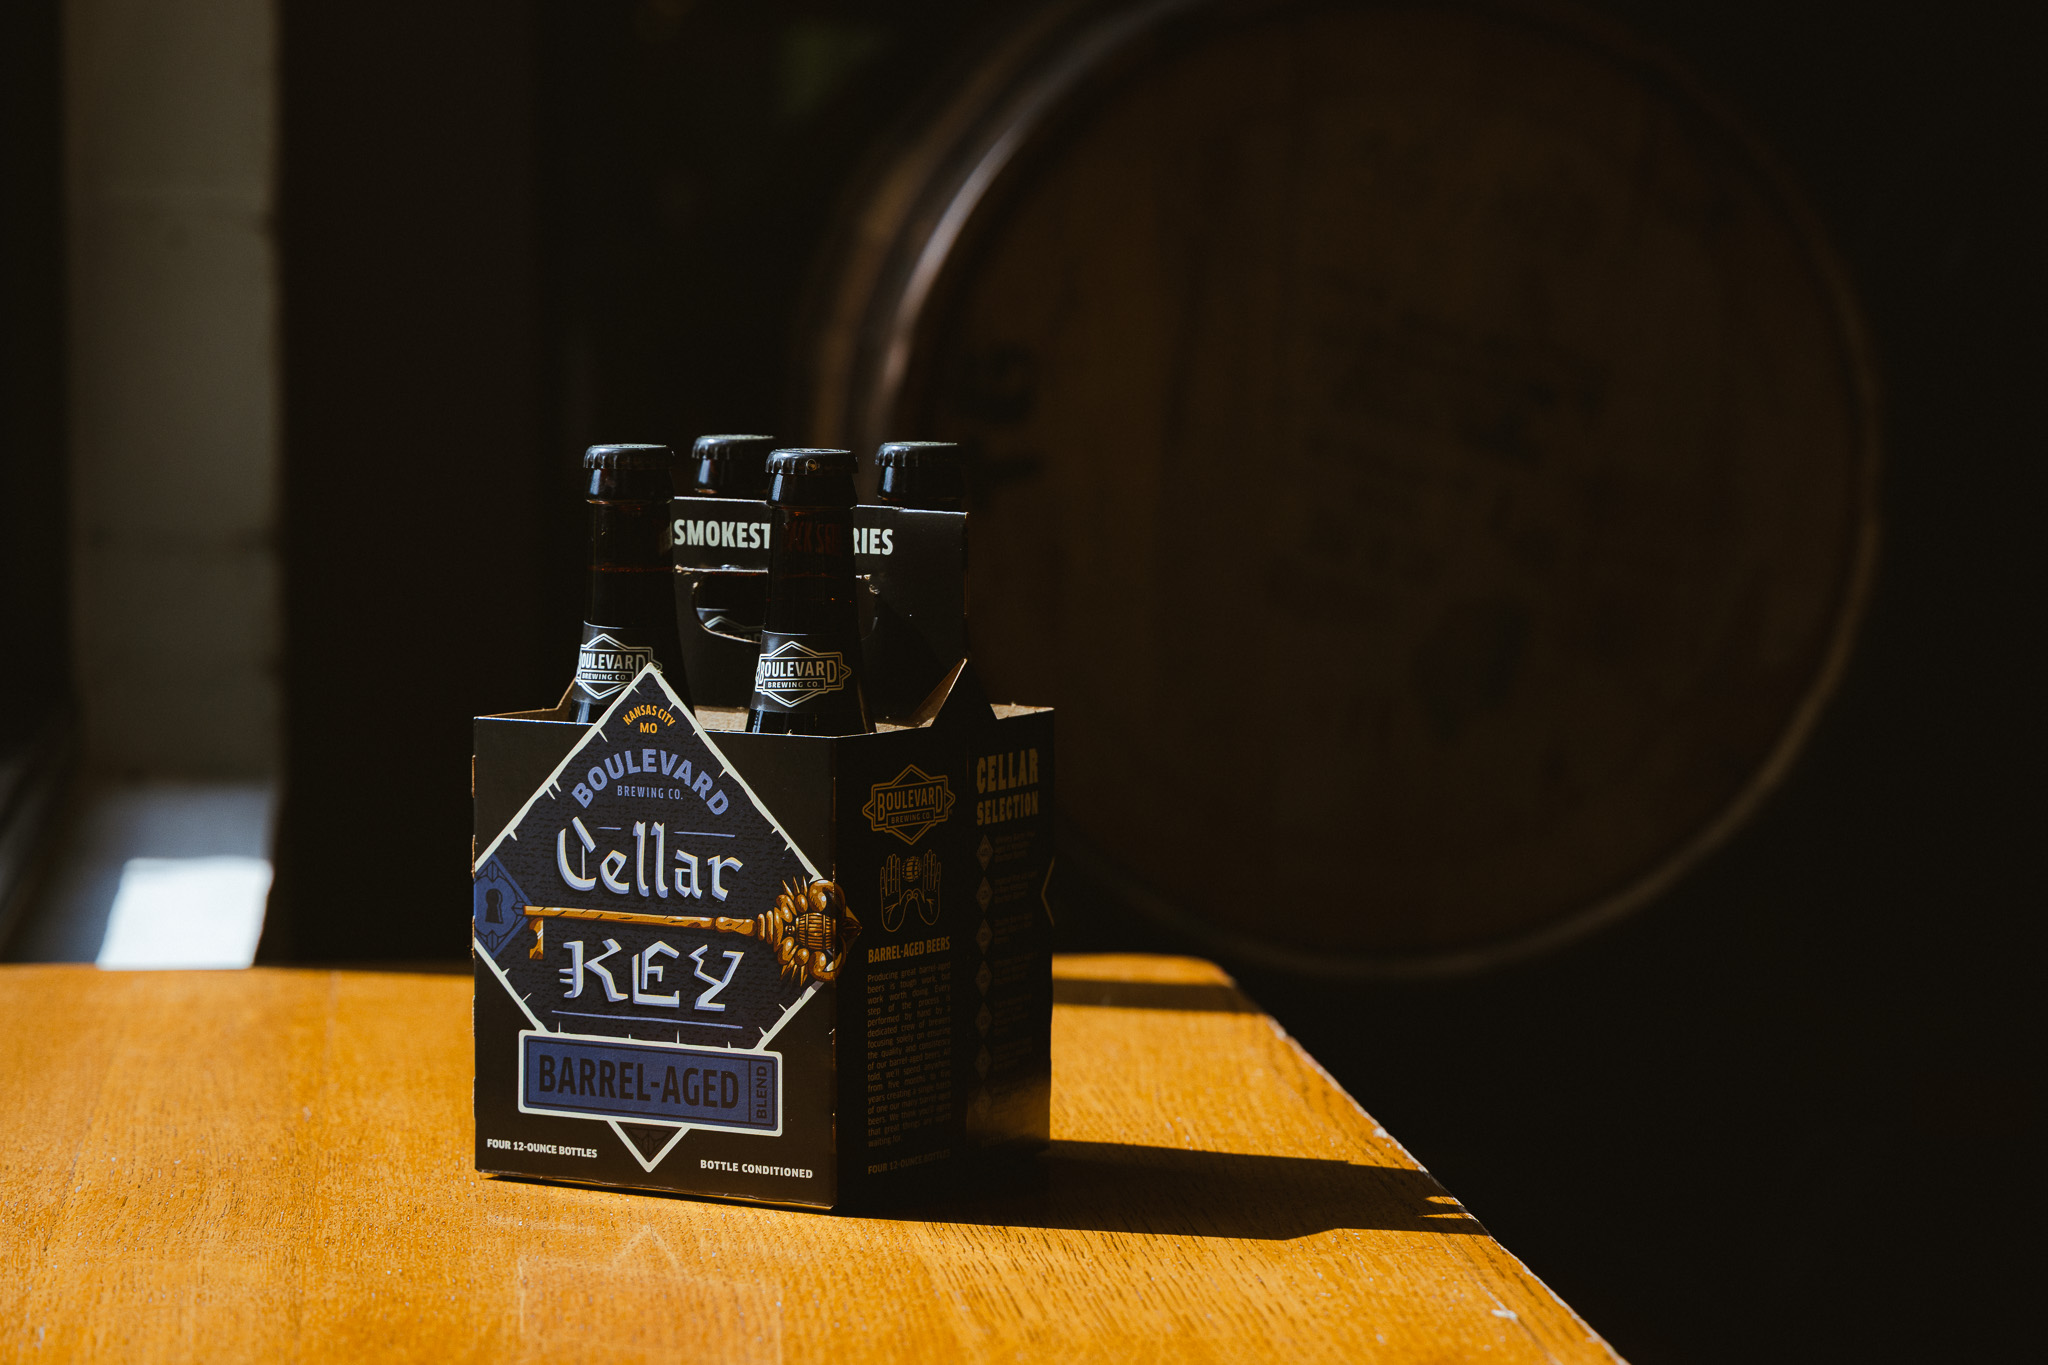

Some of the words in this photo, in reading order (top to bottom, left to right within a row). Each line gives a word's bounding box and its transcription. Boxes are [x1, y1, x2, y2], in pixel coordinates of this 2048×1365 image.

[580, 652, 646, 676] OULEVARD
[757, 659, 837, 684] BOULEVARD
[615, 673, 629, 681] CO.
[806, 680, 821, 688] CO.
[622, 704, 657, 726] KANSAS
[657, 707, 676, 727] CITY
[640, 722, 658, 733] MO
[976, 747, 1039, 794] CELLAR
[571, 748, 729, 816] BOULEVARD
[617, 784, 665, 799] BREWING
[668, 785, 683, 801] CO.
[877, 785, 944, 821] BOULEVARD
[976, 790, 1039, 826] SELECTION
[891, 813, 920, 824] BREWING
[922, 811, 931, 820] CO.
[557, 816, 744, 901] Cellar
[868, 941, 924, 964] BARREL-AGED
[926, 935, 951, 954] BEERS
[558, 937, 745, 1012] KEY
[867, 970, 898, 983] Producing
[867, 983, 884, 993] beers
[867, 994, 883, 1004] work
[867, 1006, 880, 1016] step
[867, 1013, 899, 1027] performed
[867, 1024, 897, 1038] dedicated
[538, 1053, 740, 1109] BARREL-AGED
[867, 1082, 883, 1093] from
[756, 1065, 767, 1119] BLEND
[867, 1094, 884, 1105] years
[487, 1138, 511, 1150] FOUR
[513, 1140, 557, 1155] 12-OUNCE
[558, 1145, 598, 1158] BOTTLES
[700, 1159, 739, 1172] BOTTLE
[741, 1163, 813, 1179] CONDITIONED
[868, 1162, 888, 1175] FOUR
